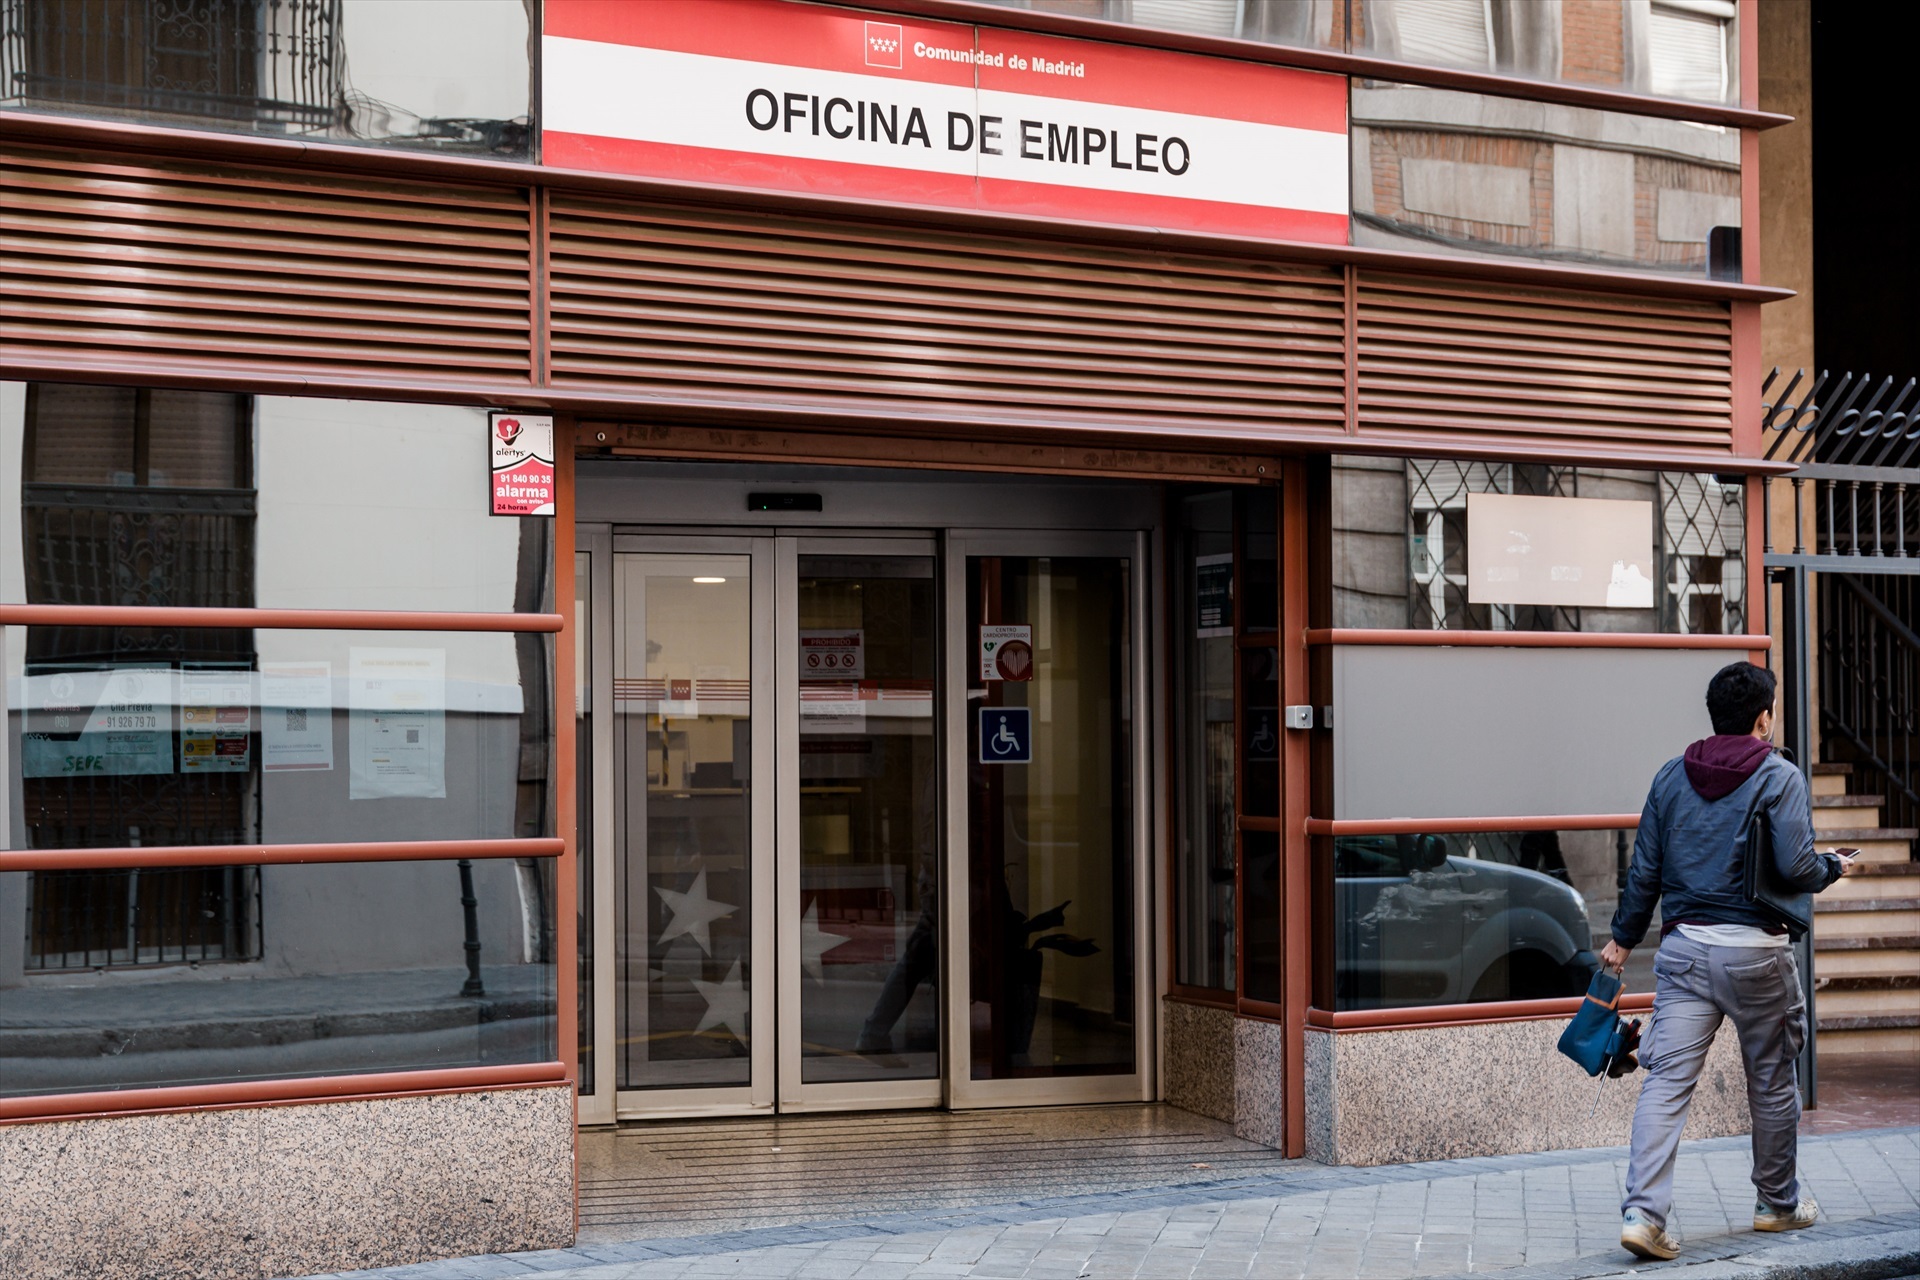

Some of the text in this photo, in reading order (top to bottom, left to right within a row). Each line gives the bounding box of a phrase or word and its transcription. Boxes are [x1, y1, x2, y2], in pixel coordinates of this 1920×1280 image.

[913, 41, 1085, 78] Comunidad de Madrid
[745, 87, 1191, 177] OFICINA DE EMPLEO
[496, 447, 525, 458] alertys
[500, 474, 551, 484] 91 840 90 35
[496, 484, 549, 498] alarma
[507, 503, 528, 511] horas
[110, 700, 153, 712] Cita Previa
[107, 715, 156, 728] 91 926 79 70
[62, 755, 104, 772] SEPE
